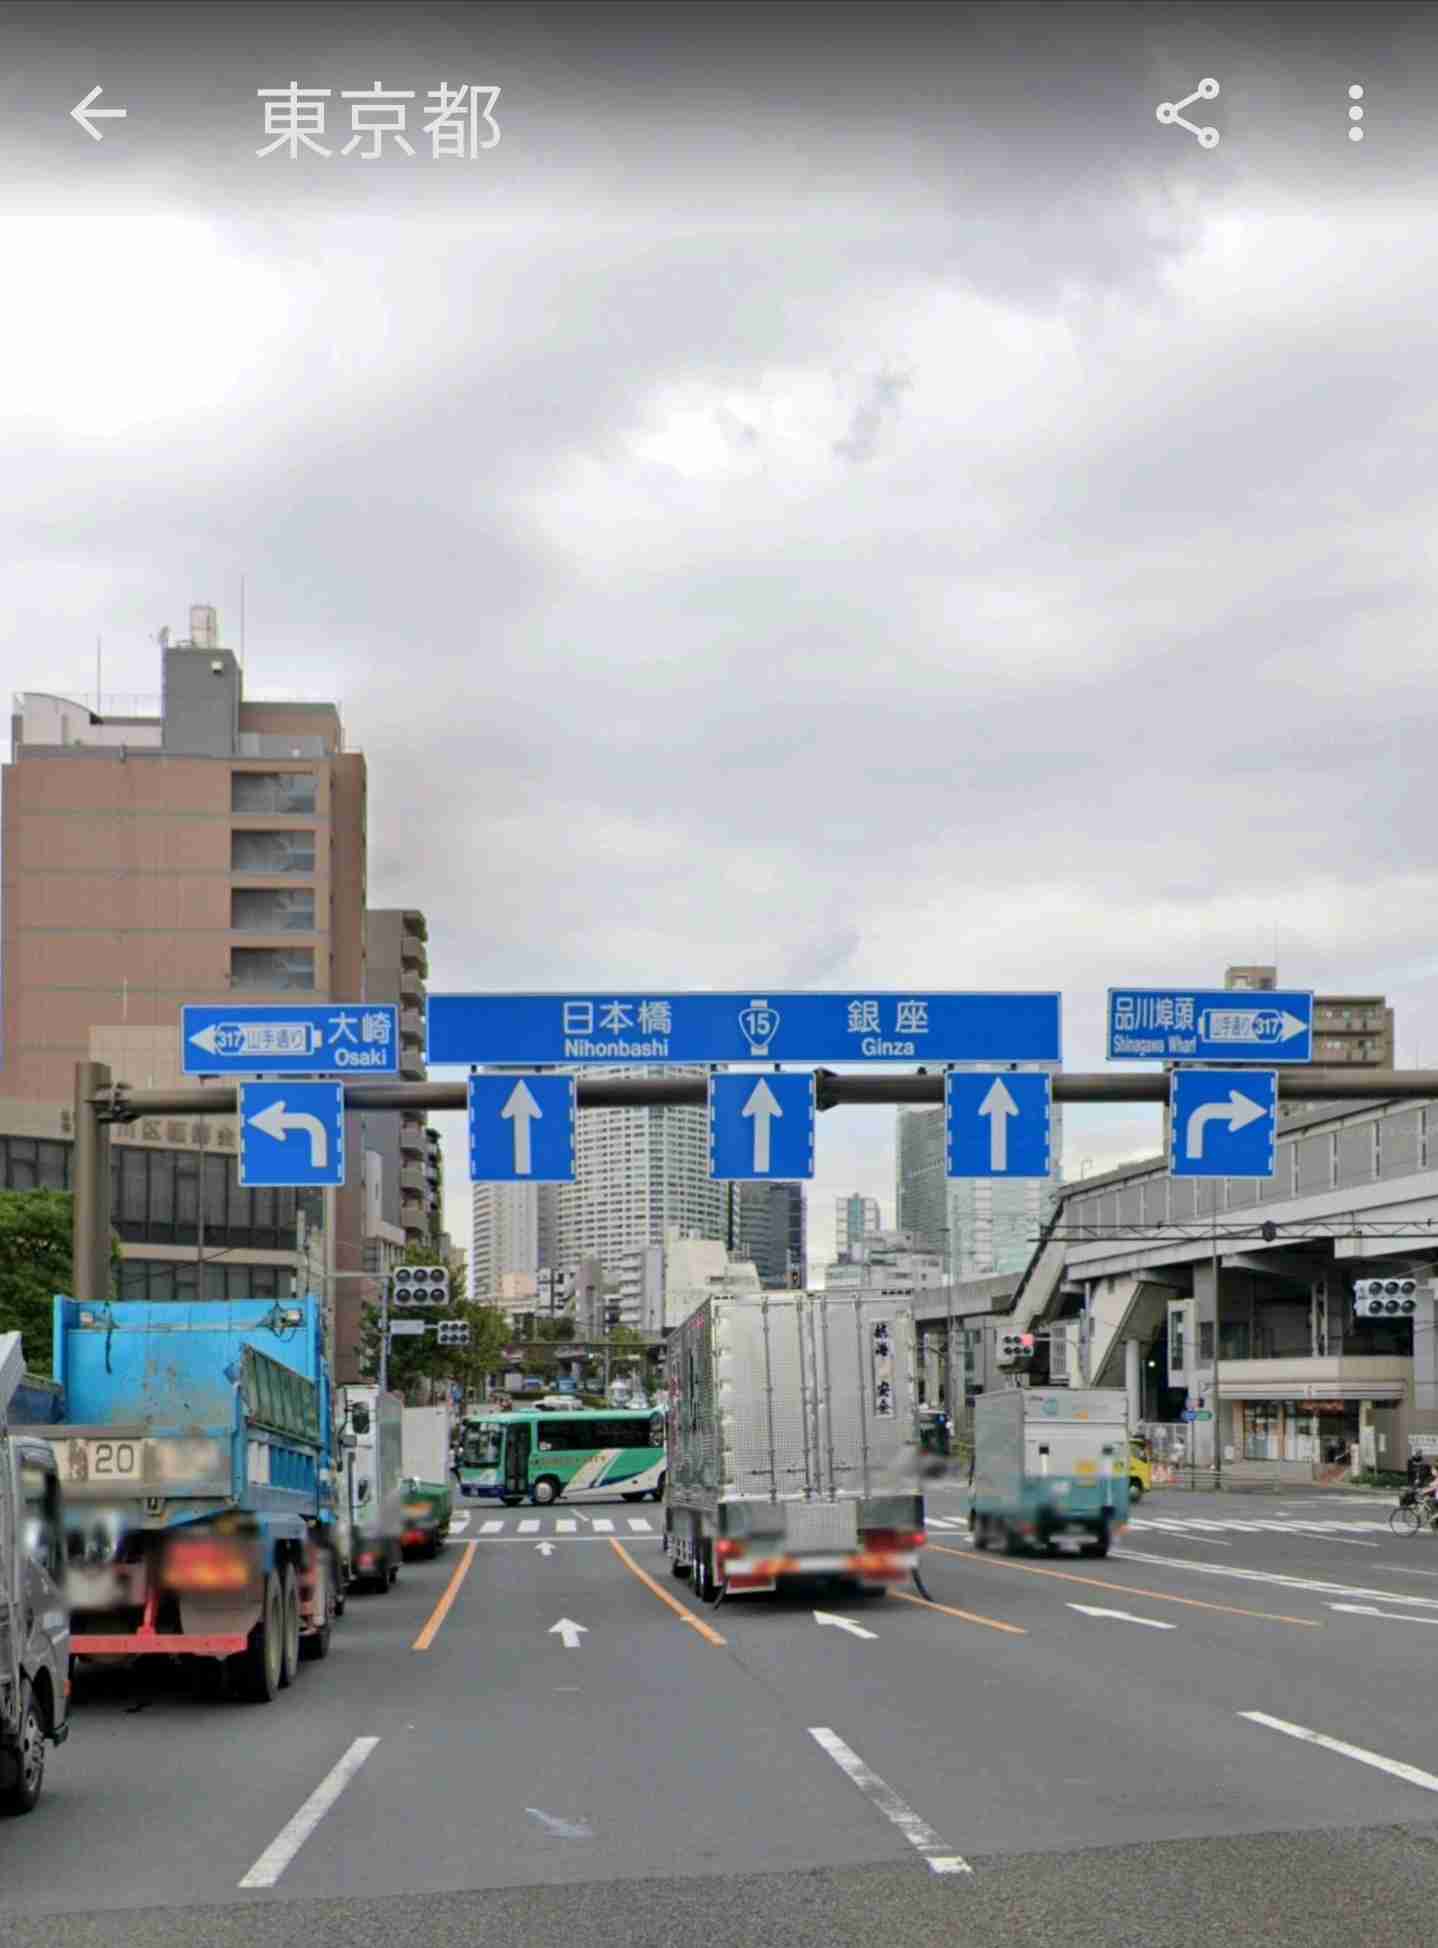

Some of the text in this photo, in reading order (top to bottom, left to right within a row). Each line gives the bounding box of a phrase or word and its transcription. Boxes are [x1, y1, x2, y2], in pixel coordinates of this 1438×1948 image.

[563, 1000, 673, 1035] 日本橋
[746, 1012, 771, 1036] 15
[847, 1000, 929, 1034] 銀座
[1114, 996, 1195, 1031] 品川埠頭
[328, 1011, 392, 1045] 大崎
[1256, 1017, 1281, 1037] 317
[219, 1030, 241, 1050] 317
[564, 1038, 669, 1057] Nihonbashi
[861, 1038, 916, 1056] Ginza
[334, 1048, 387, 1067] Osaki
[95, 1443, 134, 1474] 20
